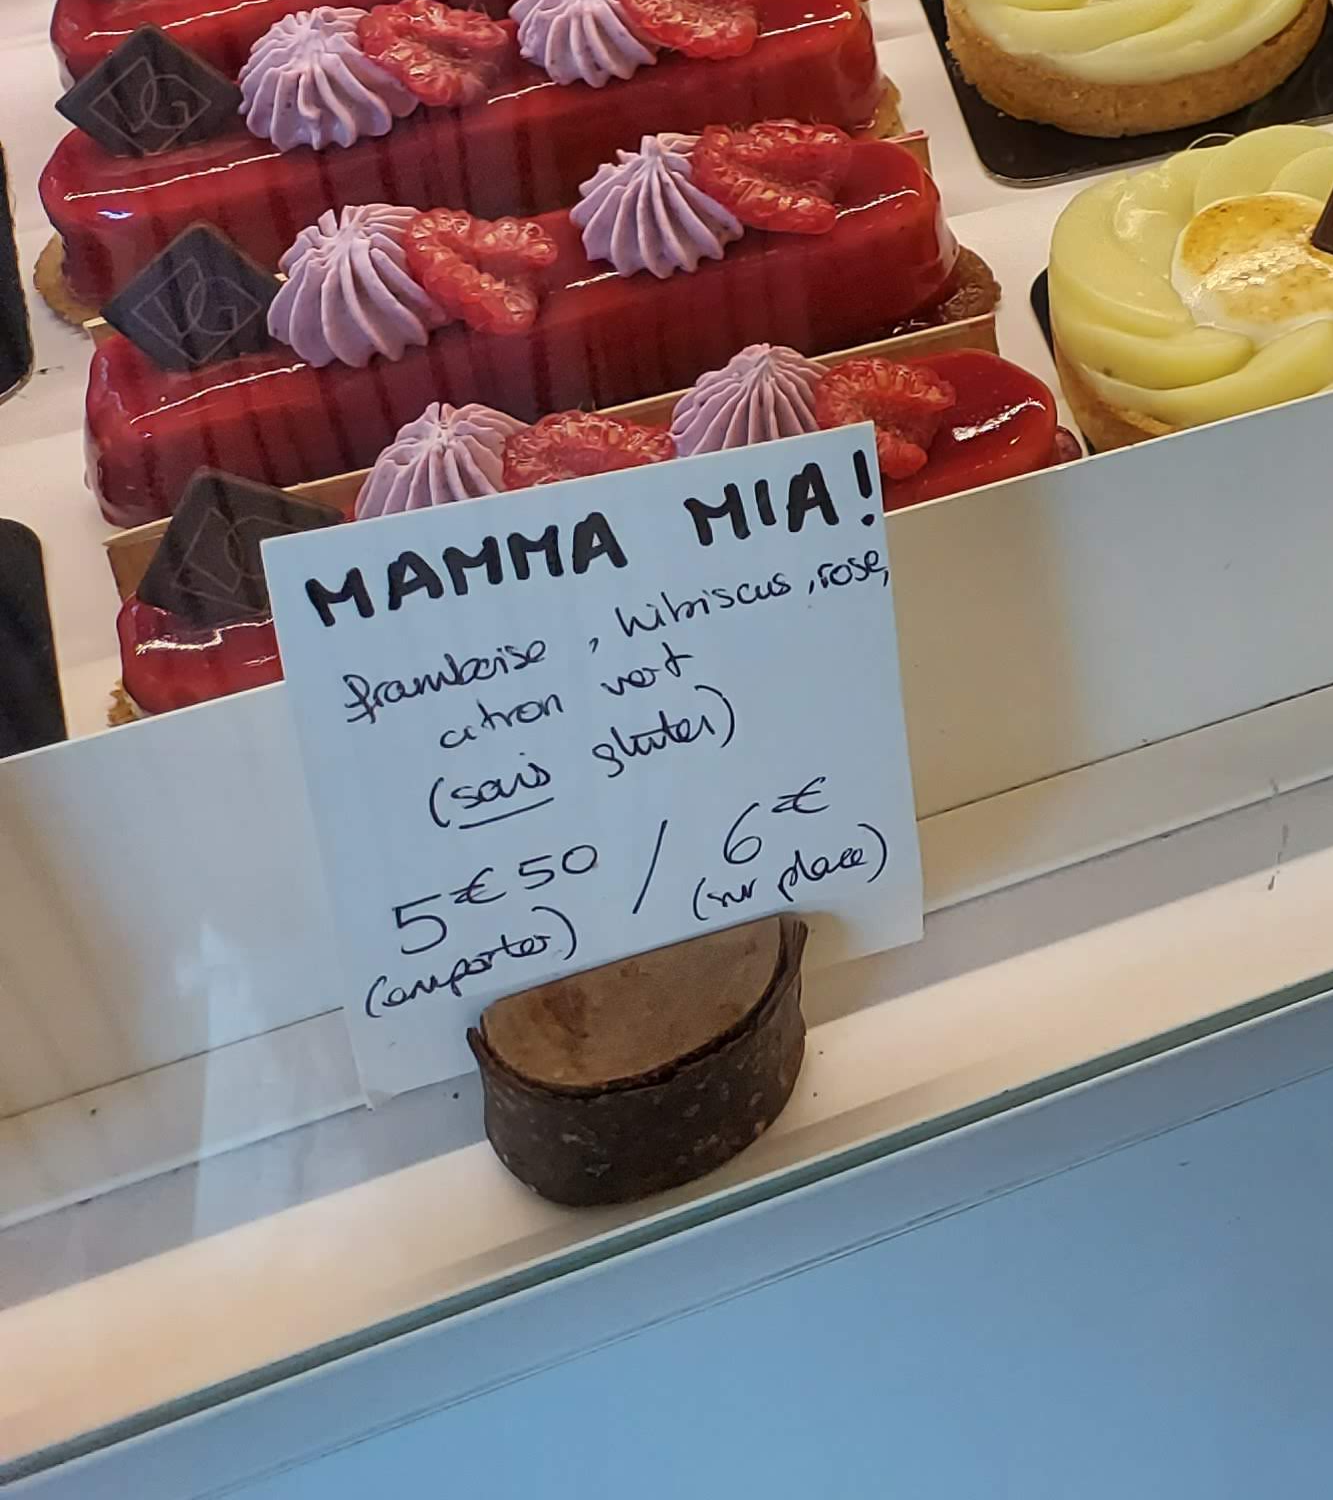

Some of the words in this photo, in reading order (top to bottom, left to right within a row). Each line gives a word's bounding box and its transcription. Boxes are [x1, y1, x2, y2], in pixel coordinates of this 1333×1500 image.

[304, 511, 629, 628] MAMMA
[683, 449, 876, 547] MIA!
[342, 639, 547, 725] framboise
[438, 693, 565, 749] citron
[391, 843, 600, 955] 5€50
[723, 775, 831, 865] 6€
